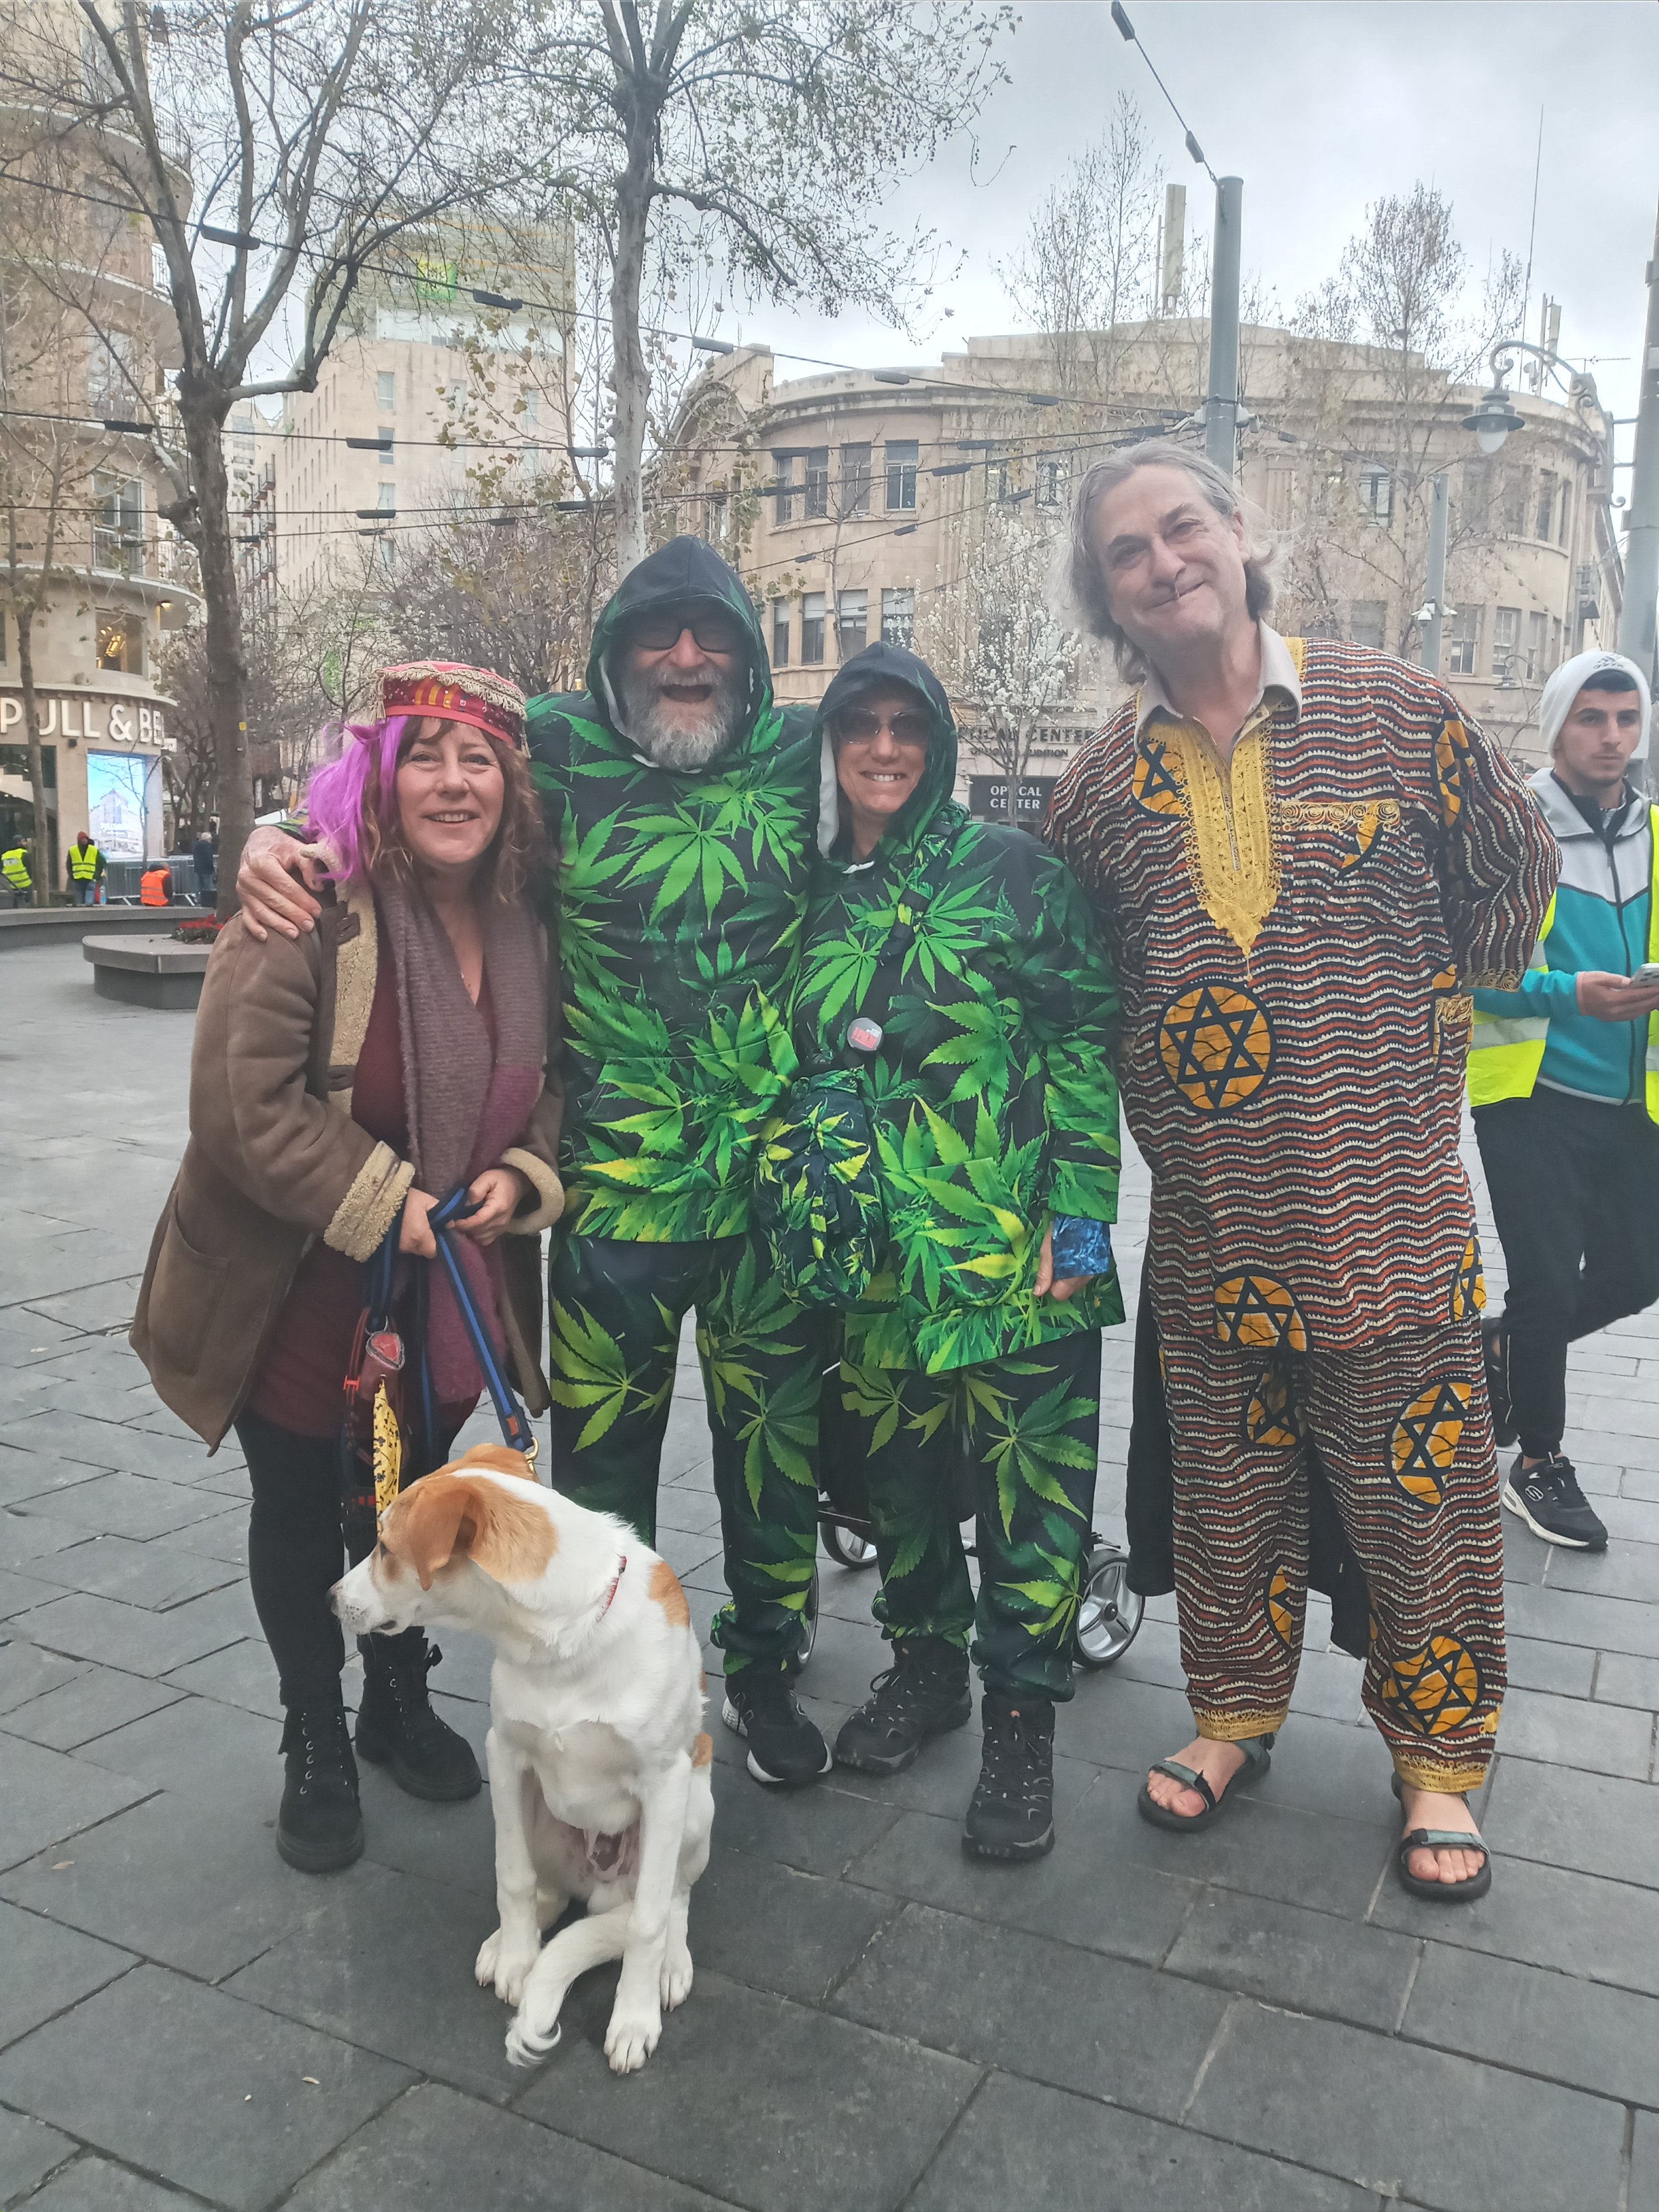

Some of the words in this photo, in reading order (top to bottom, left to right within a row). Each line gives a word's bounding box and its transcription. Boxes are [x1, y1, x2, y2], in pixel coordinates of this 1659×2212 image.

[0, 697, 100, 738] PULL
[109, 703, 133, 741] &
[139, 707, 165, 745] BE
[1025, 749, 1069, 757] UDITION
[990, 785, 1042, 796] OPCAL
[990, 798, 1040, 810] CETER
